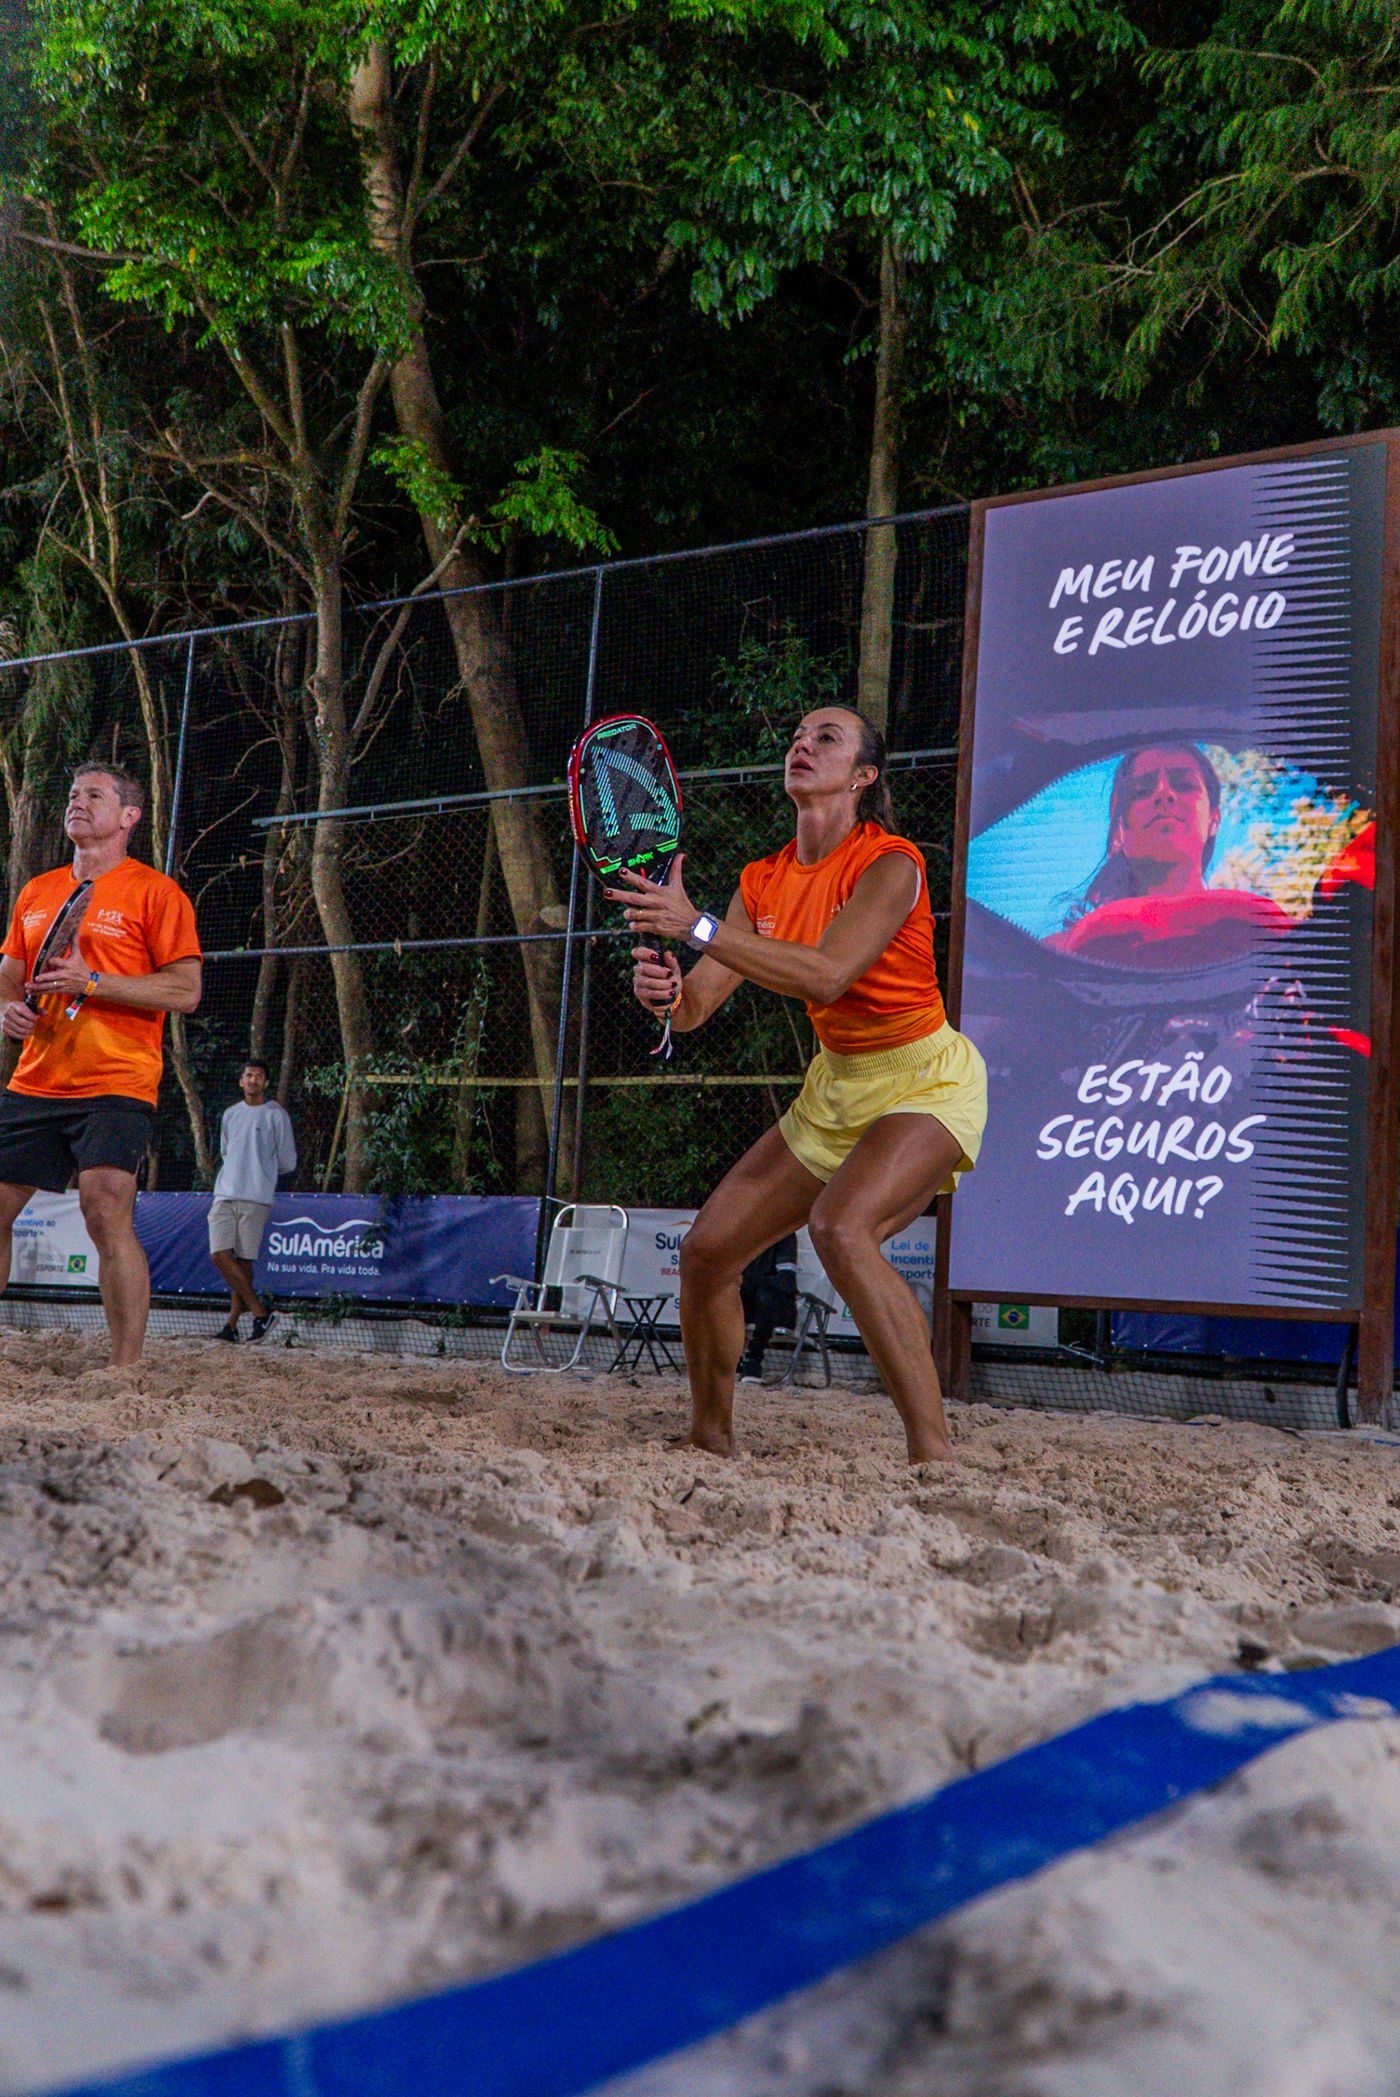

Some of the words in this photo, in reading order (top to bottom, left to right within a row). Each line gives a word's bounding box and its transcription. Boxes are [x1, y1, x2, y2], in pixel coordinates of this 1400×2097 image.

[1049, 555, 1155, 608] MEU
[1169, 533, 1295, 588] FONE
[1053, 616, 1083, 655] E
[1088, 590, 1286, 655] RELÓGIO
[597, 724, 637, 740] PREDATOR
[1077, 1051, 1232, 1106] ESTÃO
[1036, 1114, 1267, 1165] SEGUROS
[1064, 1171, 1224, 1225] AQUI?
[13, 1229, 38, 1238] sporte
[655, 1232, 682, 1250] Sul
[268, 1232, 384, 1259] SulAmérica
[891, 1239, 911, 1250] Lei
[914, 1240, 929, 1251] de
[891, 1253, 934, 1265] Incenti
[267, 1262, 279, 1272] Na
[281, 1263, 297, 1273] sua
[299, 1262, 319, 1274] vida.
[321, 1263, 335, 1274] Pra
[337, 1264, 356, 1275] vida
[358, 1265, 381, 1276] toda.
[661, 1267, 680, 1277] BEA
[971, 1317, 992, 1328] RTE
